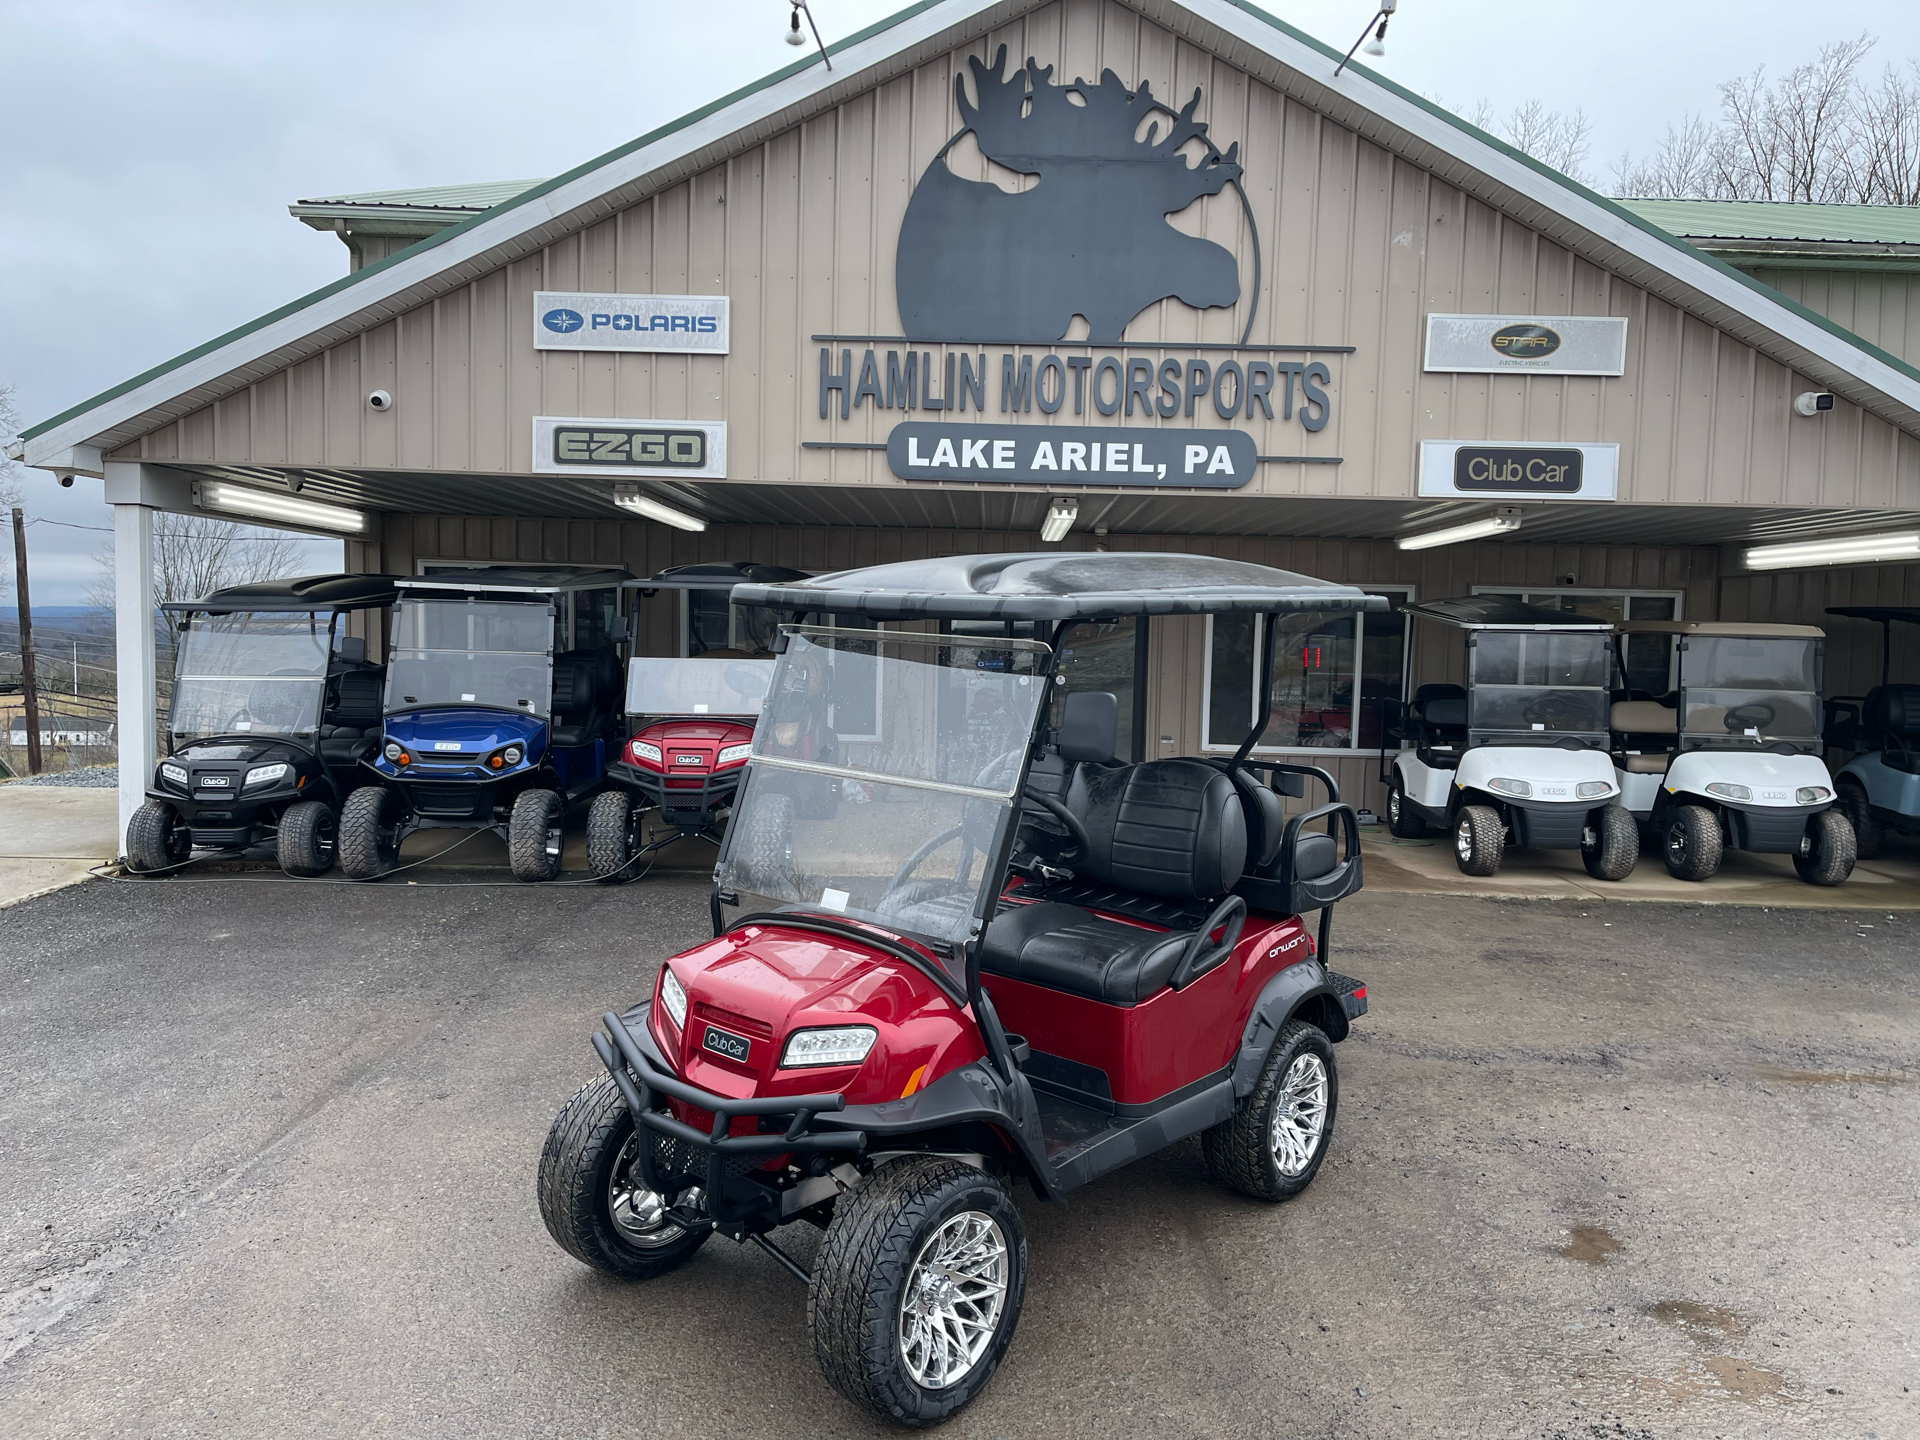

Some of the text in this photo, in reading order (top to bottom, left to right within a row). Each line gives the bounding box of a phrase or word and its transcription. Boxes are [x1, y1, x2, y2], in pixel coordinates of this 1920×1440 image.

[591, 313, 717, 333] POLARIS
[1494, 336, 1549, 348] STAR
[819, 347, 1331, 432] HAMLIN MOTORSPORTS
[558, 431, 701, 463] EZGO
[908, 436, 1236, 480] LAKE ARIEL, PA
[1468, 457, 1569, 483] Club Car
[708, 1032, 745, 1056] Club Car
